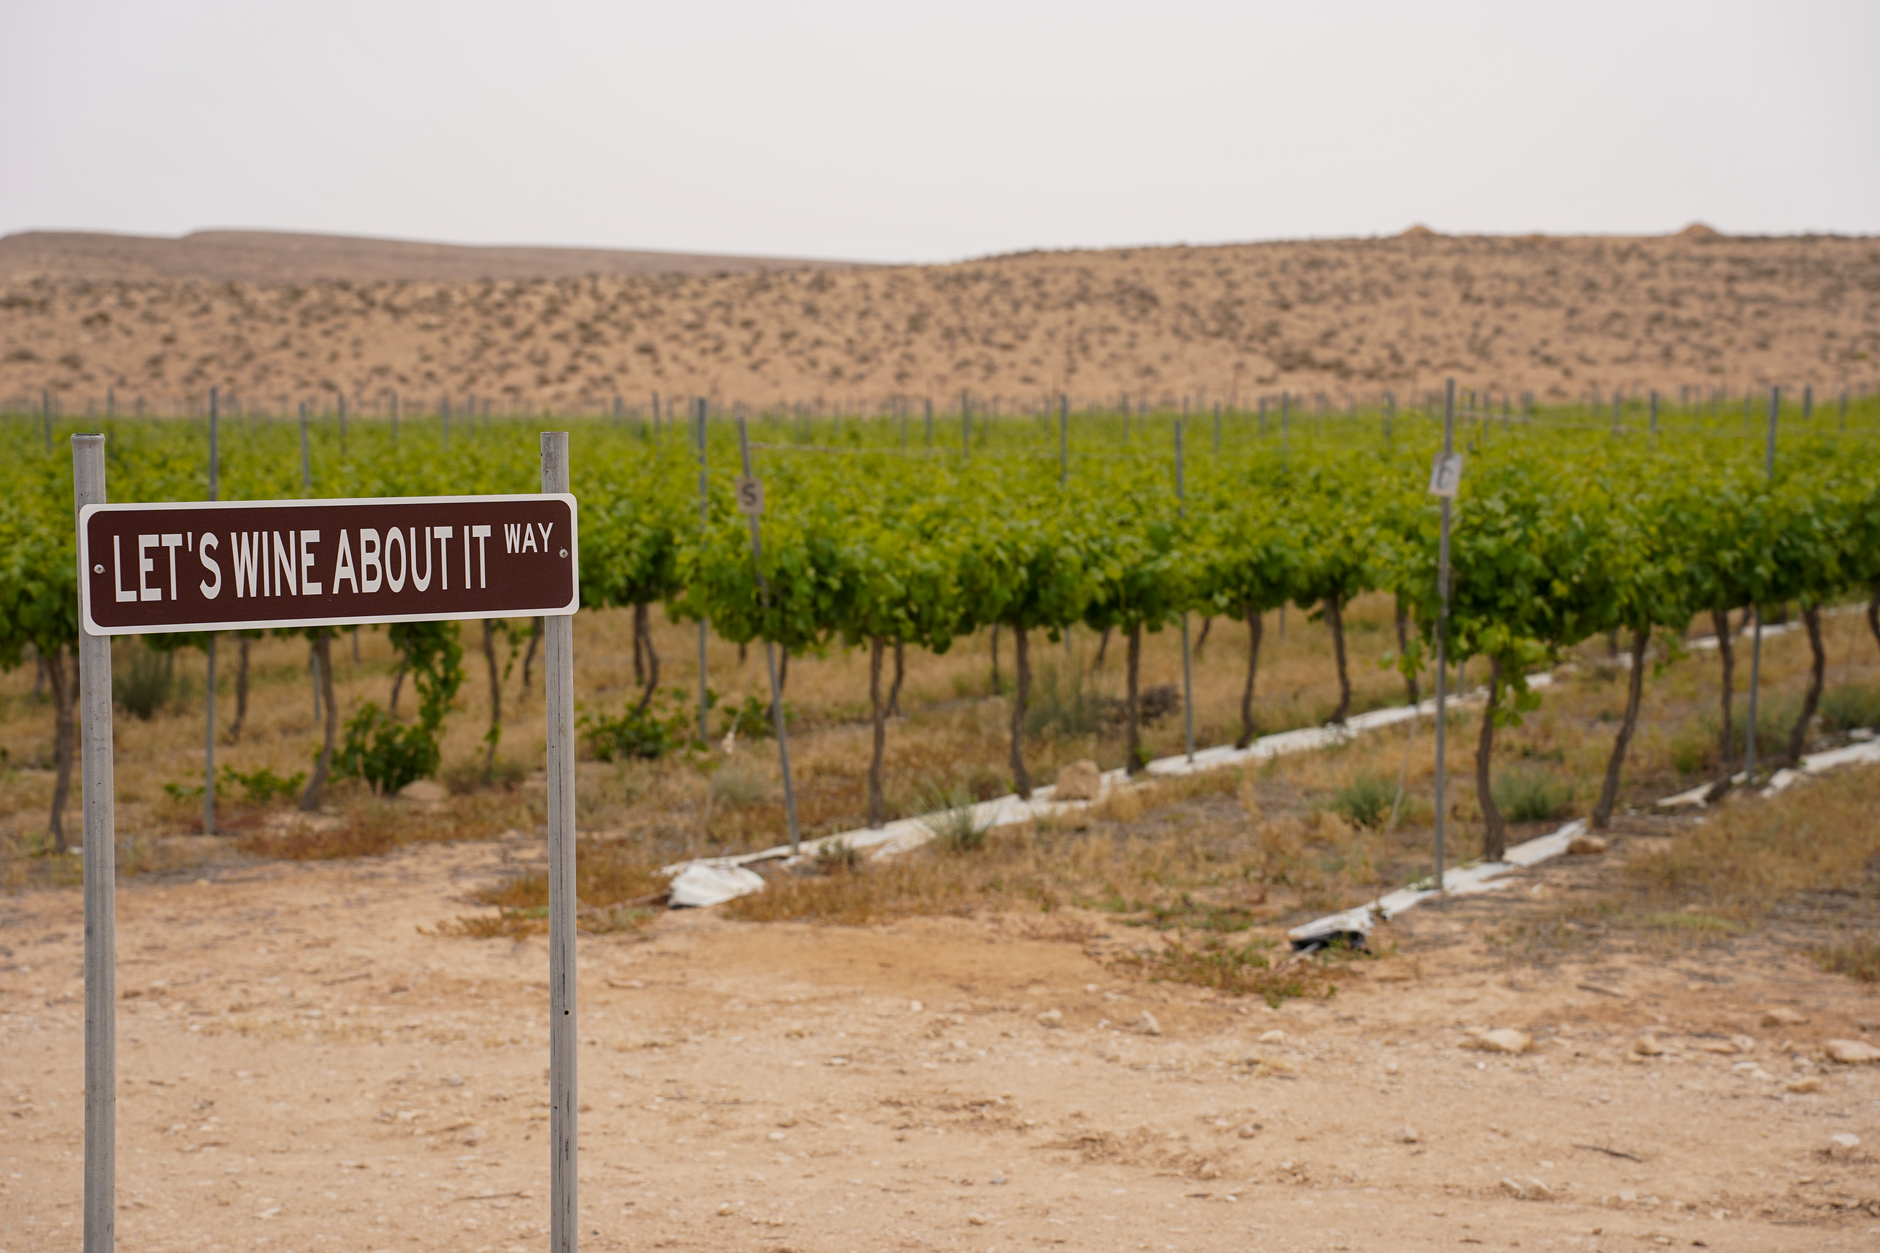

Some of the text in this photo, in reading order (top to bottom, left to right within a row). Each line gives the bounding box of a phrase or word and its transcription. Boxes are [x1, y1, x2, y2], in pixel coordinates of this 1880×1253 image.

[112, 522, 554, 603] LET'S WINE ABOUT IT WAY
